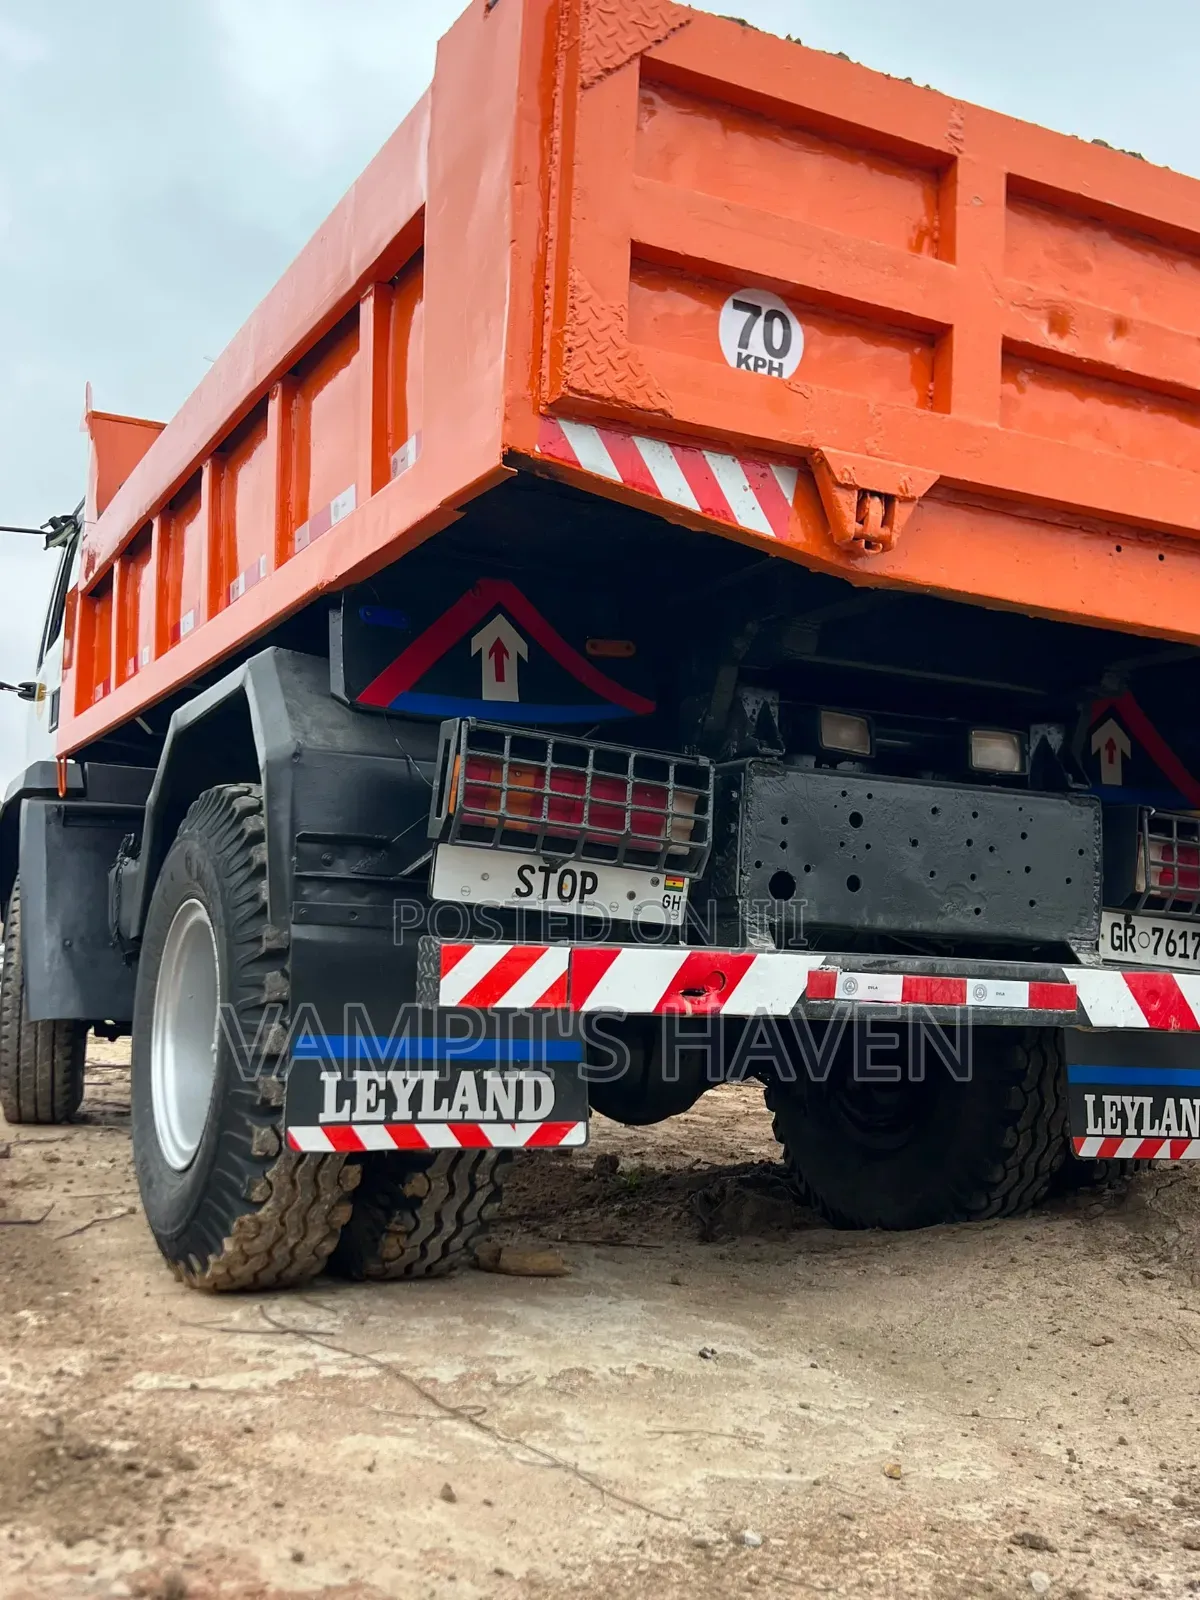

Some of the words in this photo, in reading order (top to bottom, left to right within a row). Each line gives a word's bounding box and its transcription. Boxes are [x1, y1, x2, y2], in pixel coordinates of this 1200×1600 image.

[732, 298, 792, 360] 70
[736, 351, 784, 378] KPH
[515, 863, 598, 904] STOP
[662, 894, 682, 911] GH
[1111, 921, 1137, 953] GR
[318, 1070, 556, 1123] LEYLAND
